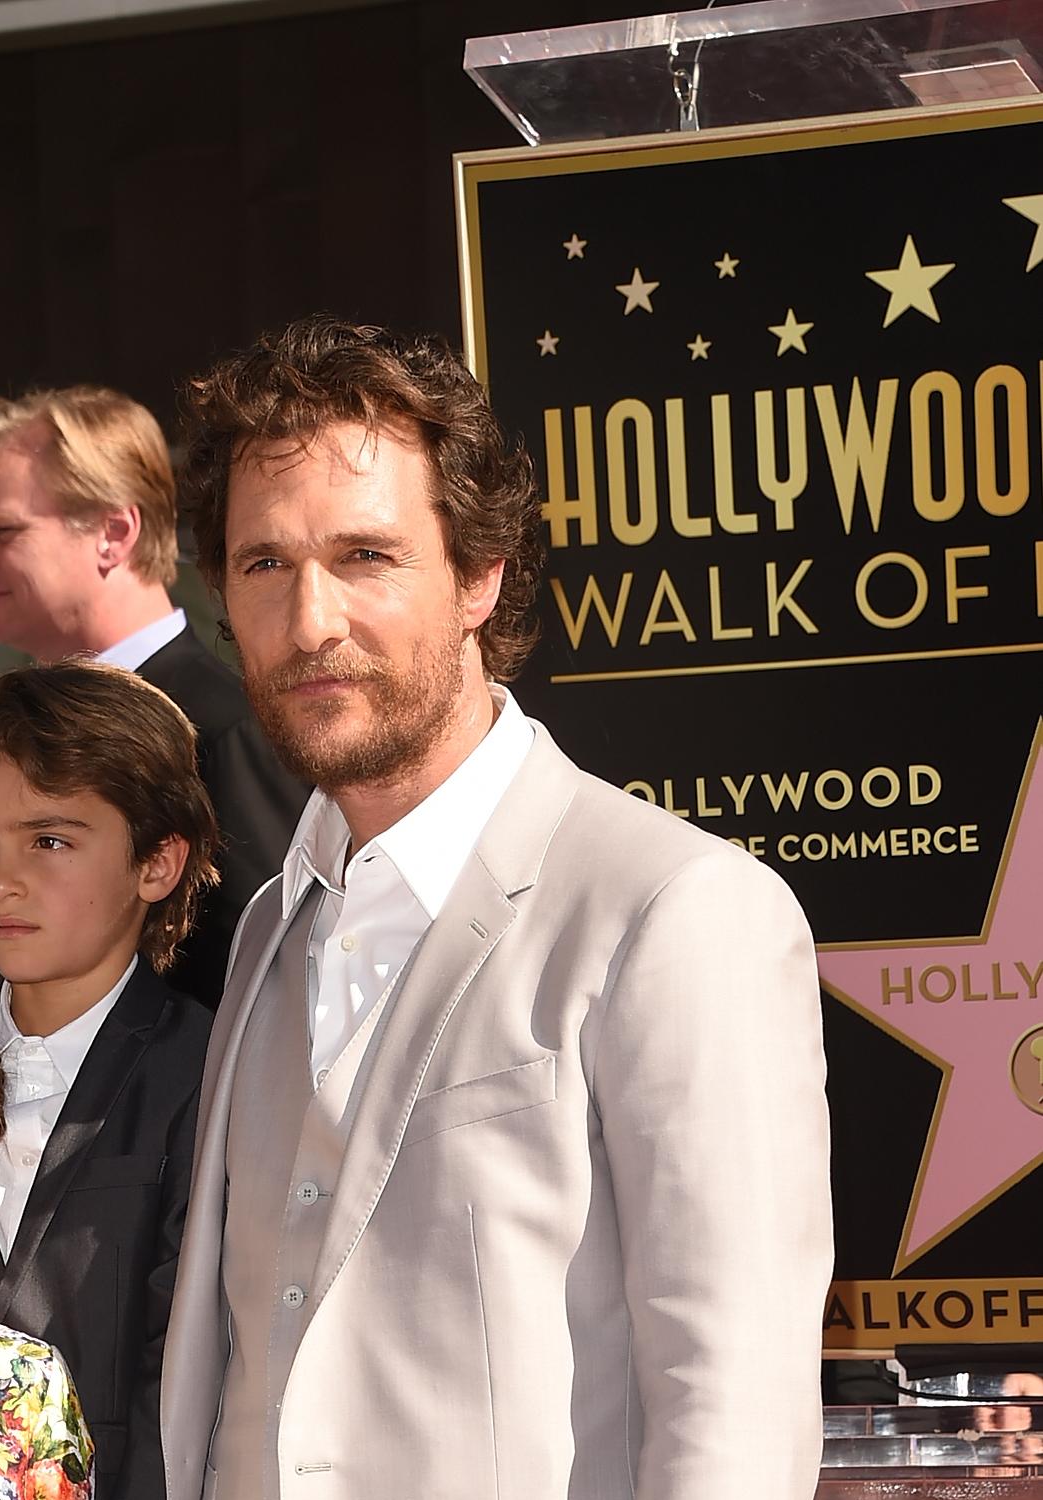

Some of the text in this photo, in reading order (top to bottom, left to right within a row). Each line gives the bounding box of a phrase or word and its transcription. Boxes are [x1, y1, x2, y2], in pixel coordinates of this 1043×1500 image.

[542, 361, 1043, 548] HOLLYWOO
[550, 559, 819, 650] WALK
[855, 545, 990, 629] OF
[622, 765, 942, 818] OLLYWOOD
[777, 824, 979, 862] COMMERCE
[881, 961, 1043, 1005] HOLLY
[824, 1290, 1043, 1330] ALKOFF
